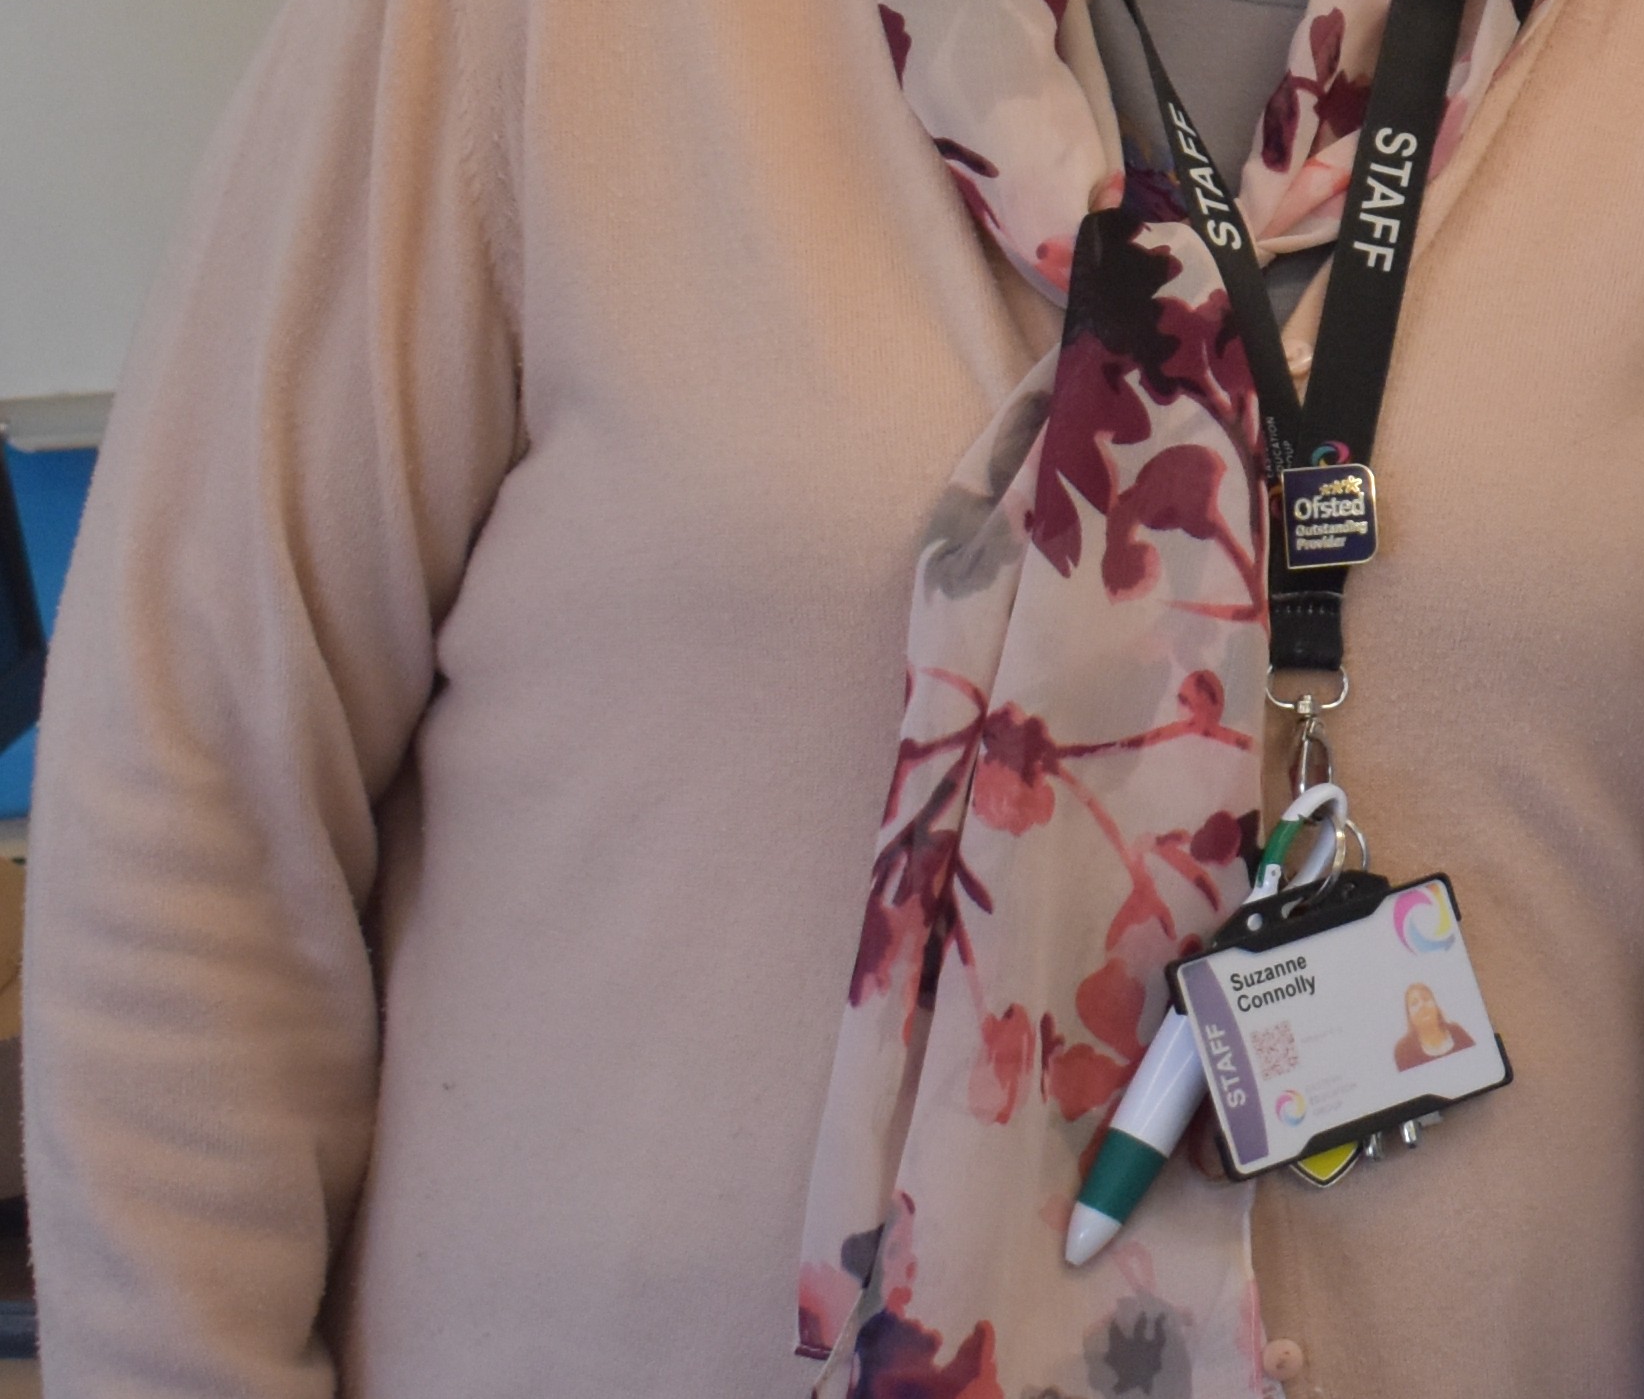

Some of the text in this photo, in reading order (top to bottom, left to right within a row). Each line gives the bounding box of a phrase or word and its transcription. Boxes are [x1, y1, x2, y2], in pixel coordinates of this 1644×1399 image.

[1167, 102, 1242, 251] STAFF
[1352, 127, 1418, 272] STAFF
[1266, 416, 1283, 472] DUCATION
[1294, 491, 1365, 521] Ofsted
[1295, 520, 1368, 537] Outstanding
[1296, 535, 1347, 551] Provider
[1229, 955, 1308, 992] Suzanne
[1237, 974, 1317, 1012] Connolly
[1205, 1023, 1247, 1110] STAFF
